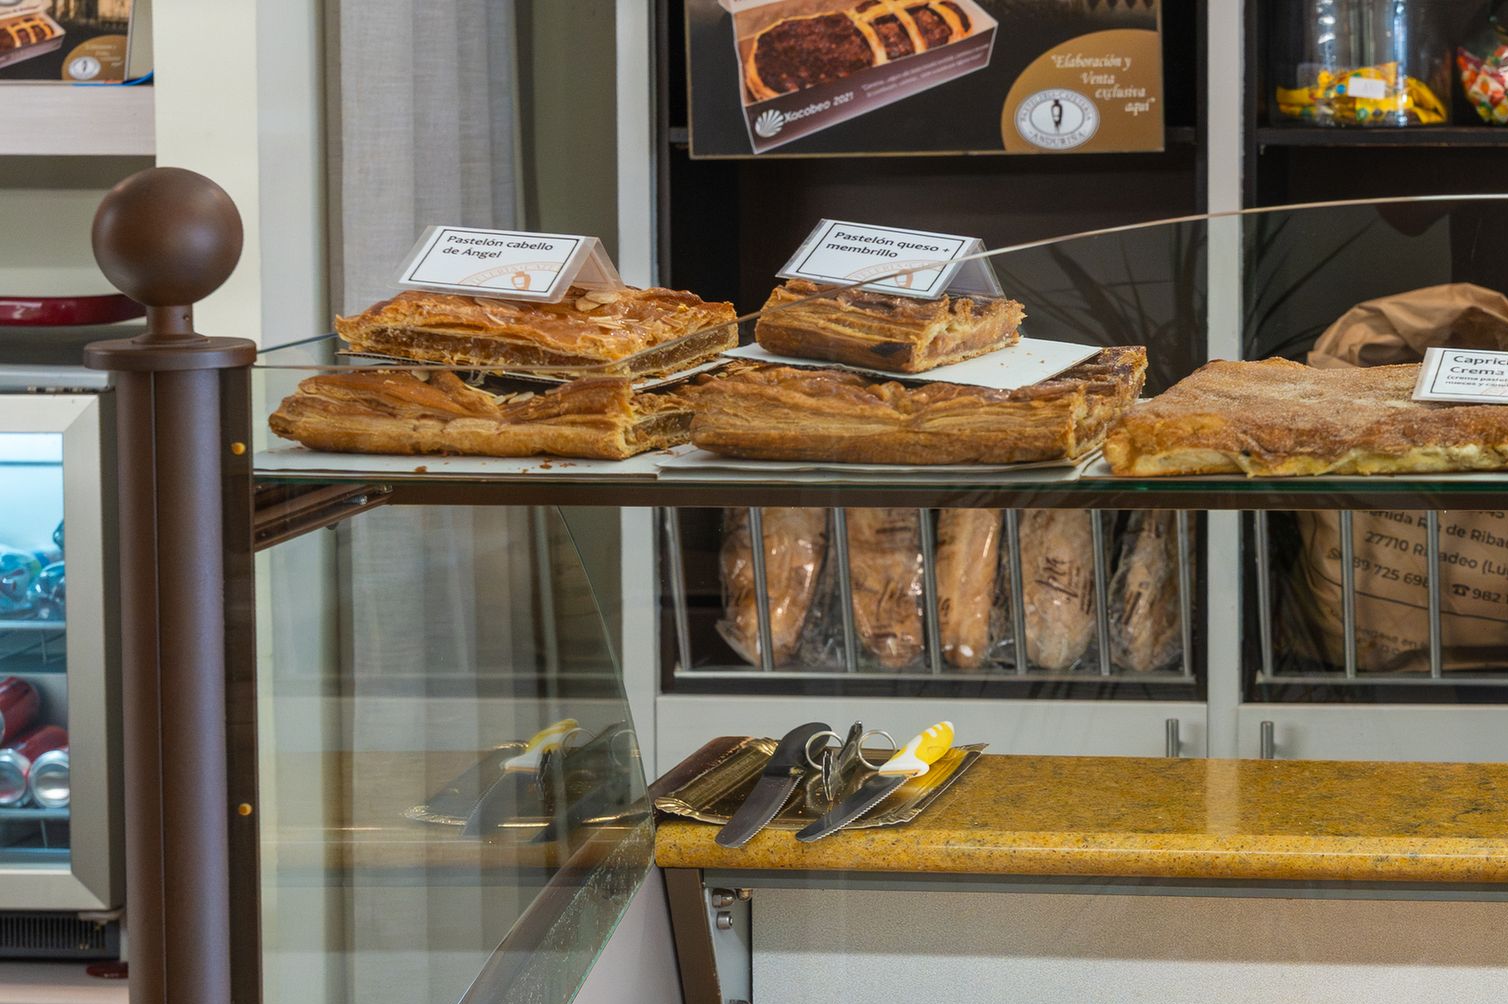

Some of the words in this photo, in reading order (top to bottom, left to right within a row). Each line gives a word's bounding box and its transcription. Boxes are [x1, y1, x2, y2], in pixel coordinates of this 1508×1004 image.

[1080, 71, 1115, 85] Venta
[1095, 84, 1146, 100] exclusiva
[783, 100, 831, 124] Xacobeo
[833, 92, 854, 107] 2021
[447, 235, 503, 248] Pastelón
[506, 240, 553, 251] cabello
[825, 242, 898, 258] membrillo
[834, 231, 894, 246] Pastelón
[896, 241, 939, 253] queso
[442, 246, 460, 255] de
[462, 247, 502, 259] Ángel
[1449, 366, 1505, 376] Crema
[1446, 523, 1466, 538] de
[1364, 531, 1409, 552] 27710
[1374, 564, 1400, 581] 725
